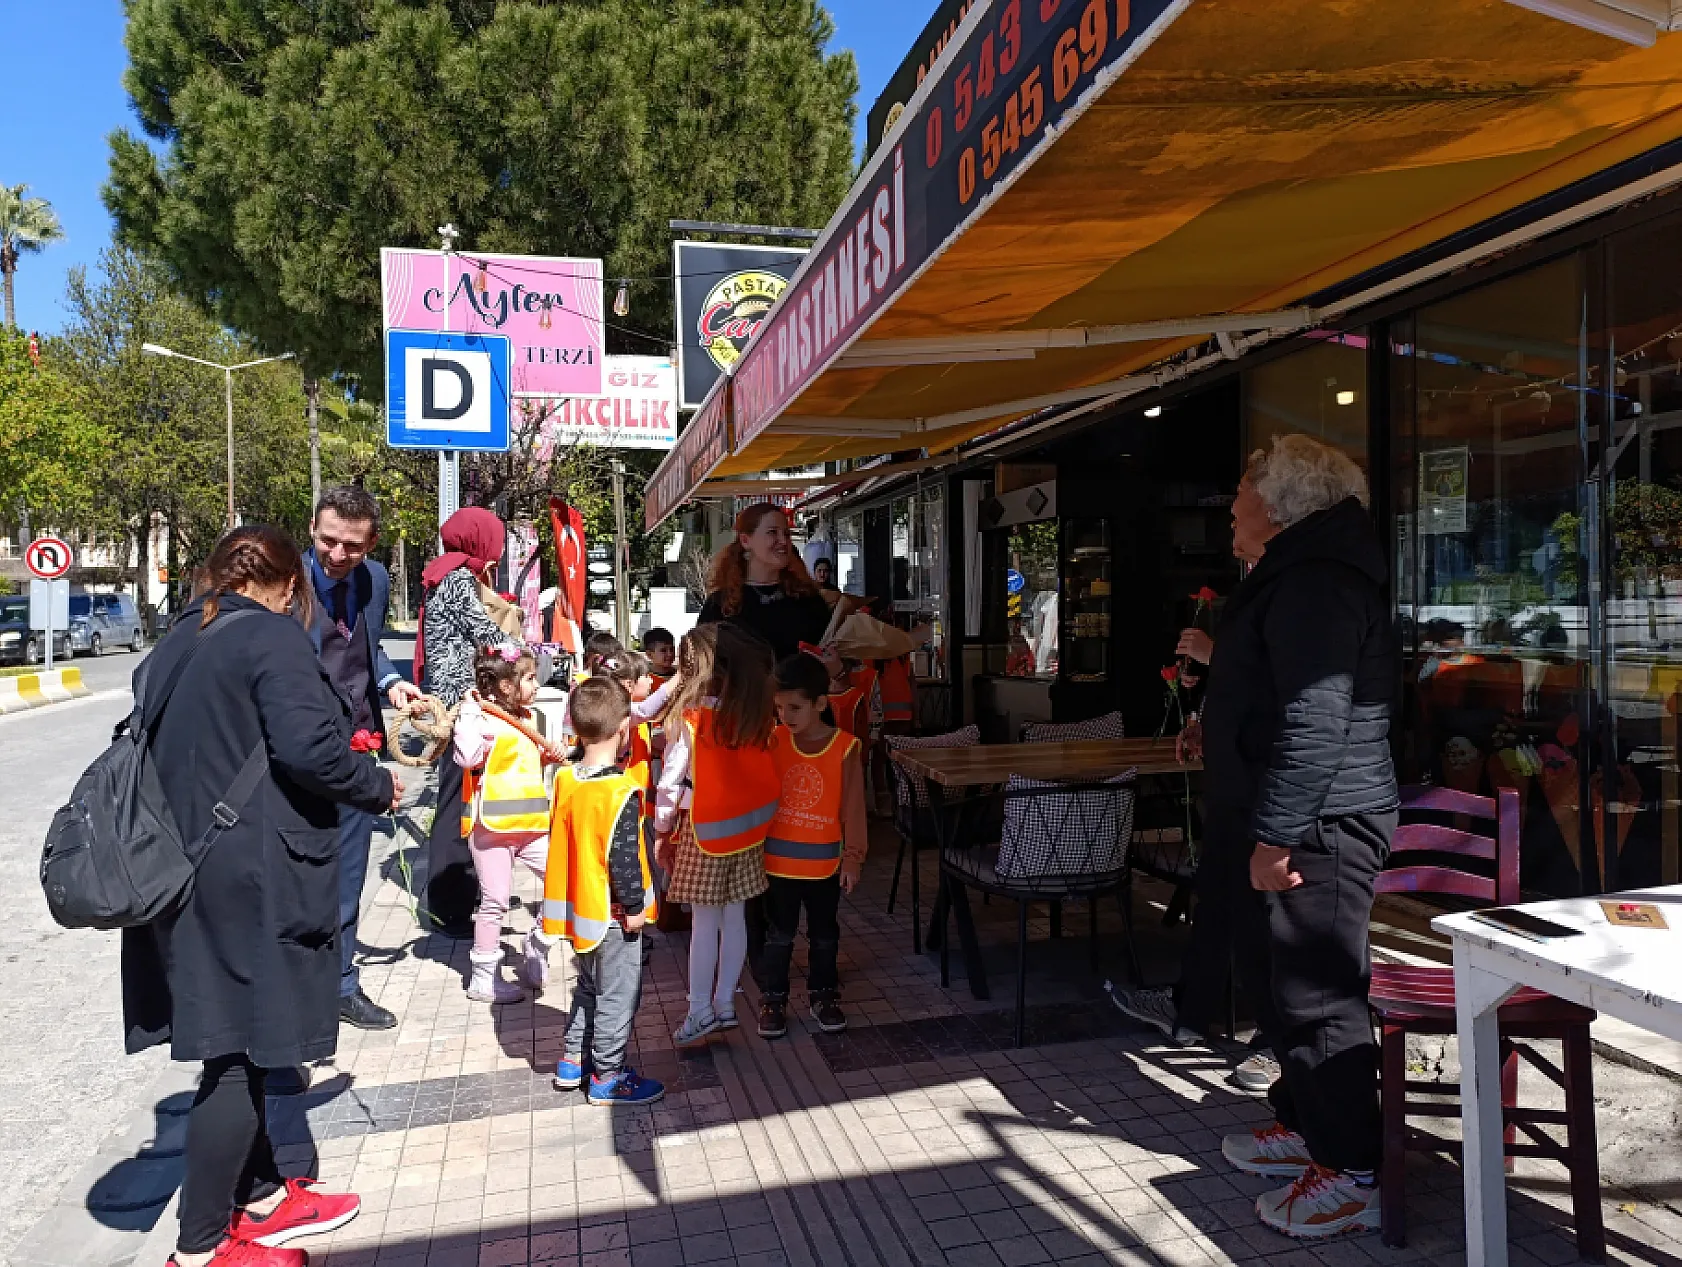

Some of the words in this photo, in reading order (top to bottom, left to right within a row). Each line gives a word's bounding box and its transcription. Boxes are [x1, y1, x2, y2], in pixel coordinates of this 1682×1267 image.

[925, 106, 942, 169] 0
[954, 0, 1022, 133] 543
[958, 147, 976, 205] 0
[981, 64, 1044, 180] 545
[777, 144, 907, 395] PASTANESİ
[421, 357, 474, 420] D
[523, 345, 595, 365] TERZİ
